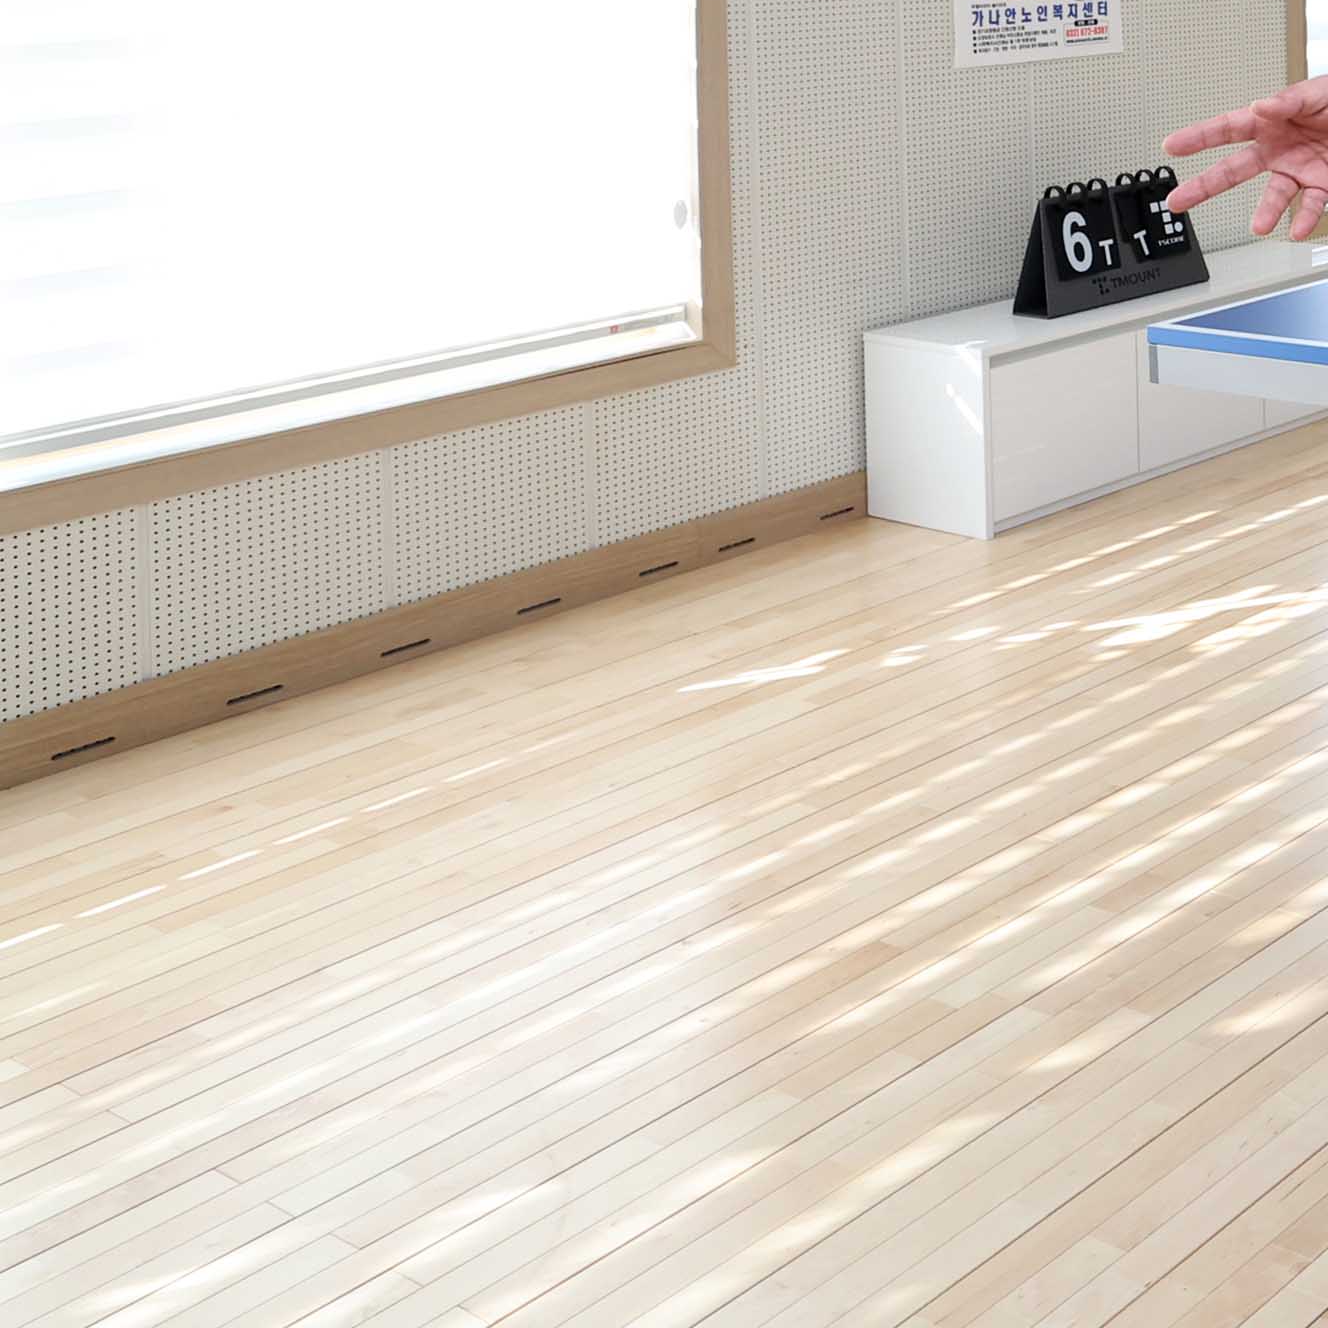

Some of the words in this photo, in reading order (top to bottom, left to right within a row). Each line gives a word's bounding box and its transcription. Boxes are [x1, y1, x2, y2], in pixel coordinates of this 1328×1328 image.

[972, 1, 1108, 27] 가나안노인복지센터
[1062, 211, 1094, 272] 6
[1099, 239, 1114, 266] T
[1133, 230, 1150, 256] T
